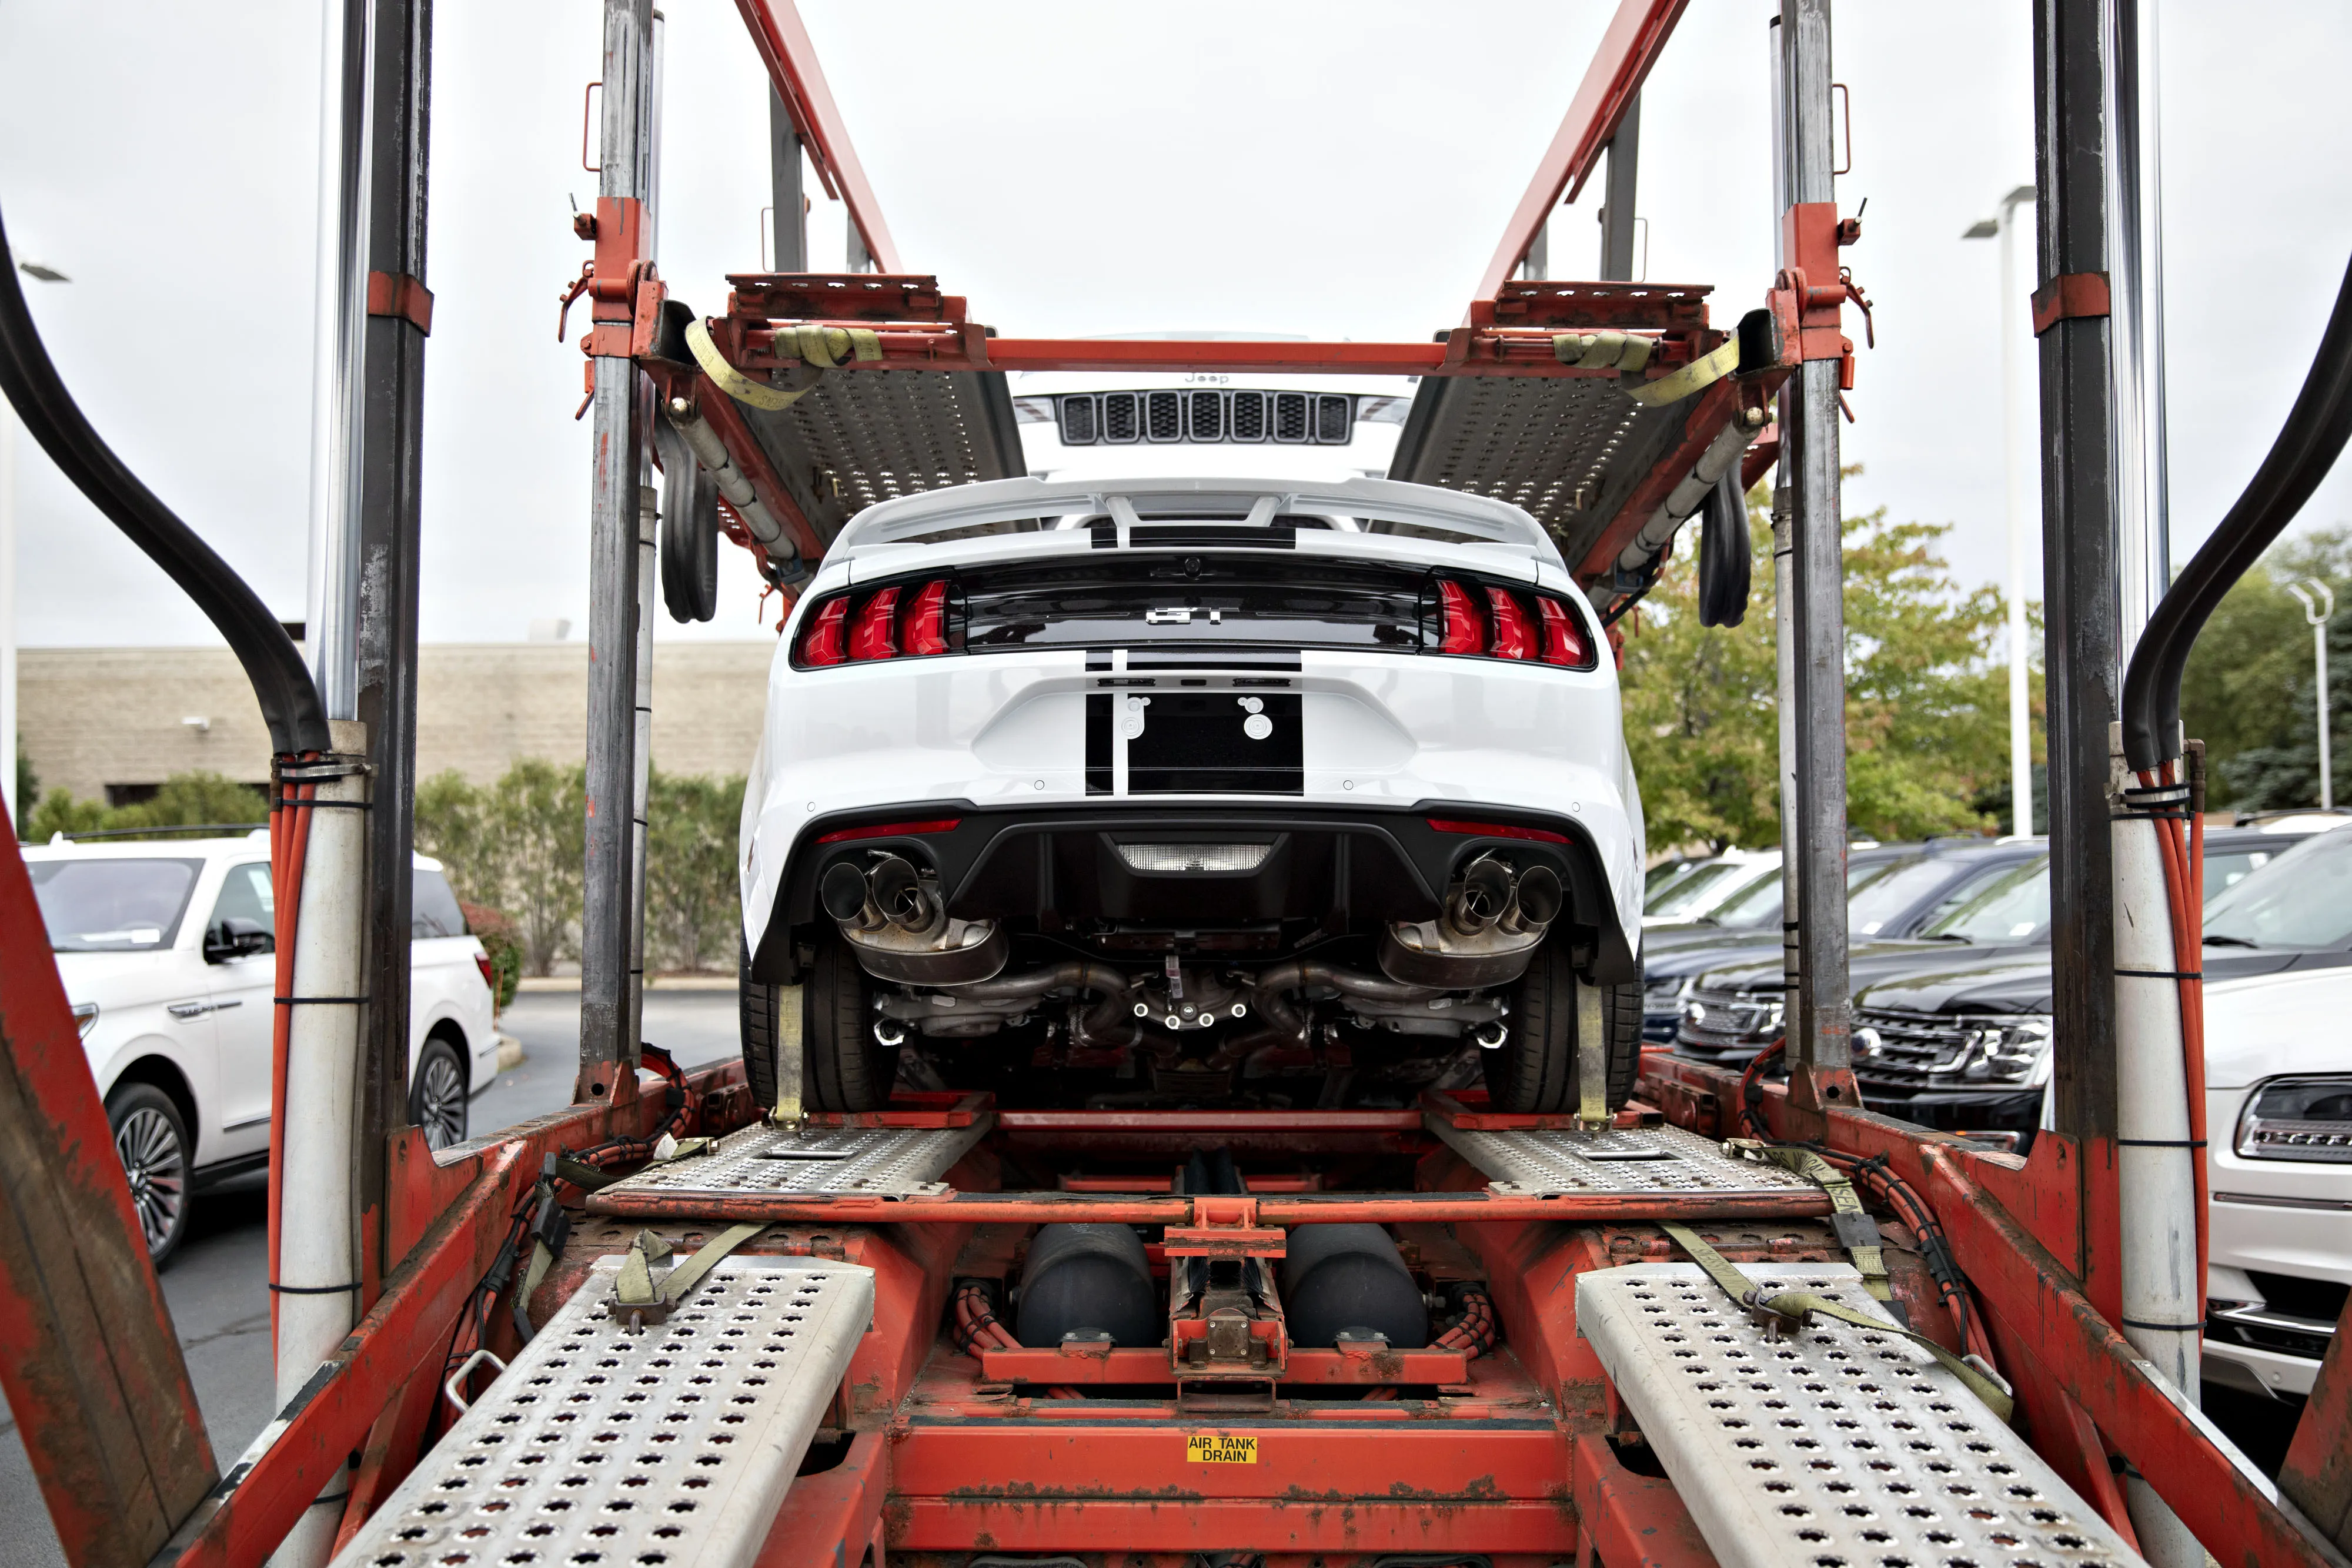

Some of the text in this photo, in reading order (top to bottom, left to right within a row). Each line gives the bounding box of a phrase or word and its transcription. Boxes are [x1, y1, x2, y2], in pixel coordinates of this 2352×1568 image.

[1184, 372, 1230, 385] Jeep
[1188, 1437, 1255, 1450] AIR TANK
[1202, 1450, 1247, 1462] DRAIN
